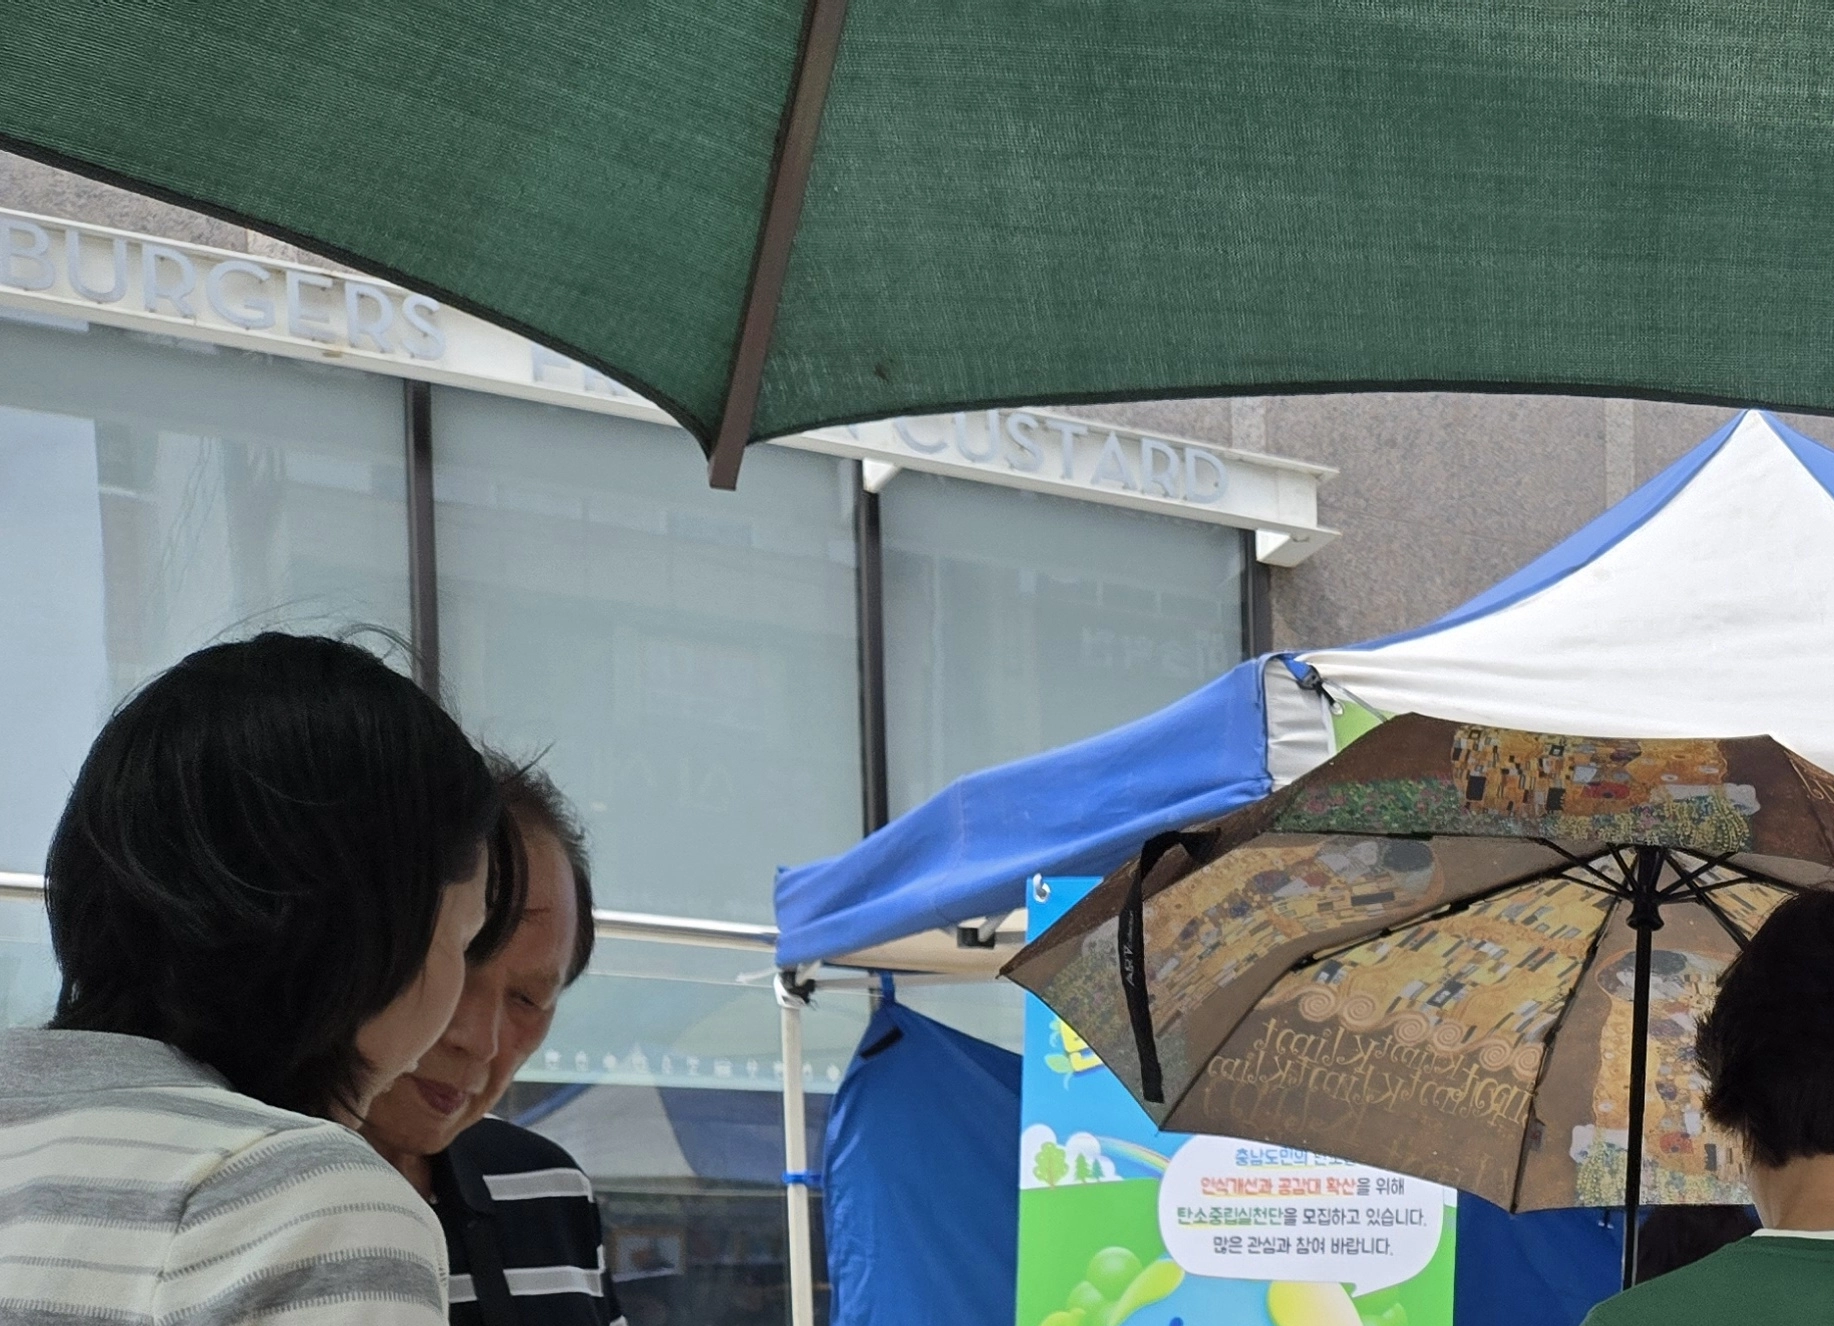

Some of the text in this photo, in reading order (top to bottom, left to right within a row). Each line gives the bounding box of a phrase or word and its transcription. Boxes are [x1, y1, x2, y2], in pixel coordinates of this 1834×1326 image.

[2, 218, 448, 361] BURGERS
[1200, 1176, 1405, 1196] 인식개선과 공감대 확산을 위해
[1177, 1206, 1428, 1228] 탄소중립실천단을 모집하고 있습니다.
[1213, 1235, 1394, 1257] 많은 관심과 참여 바랍니다.
